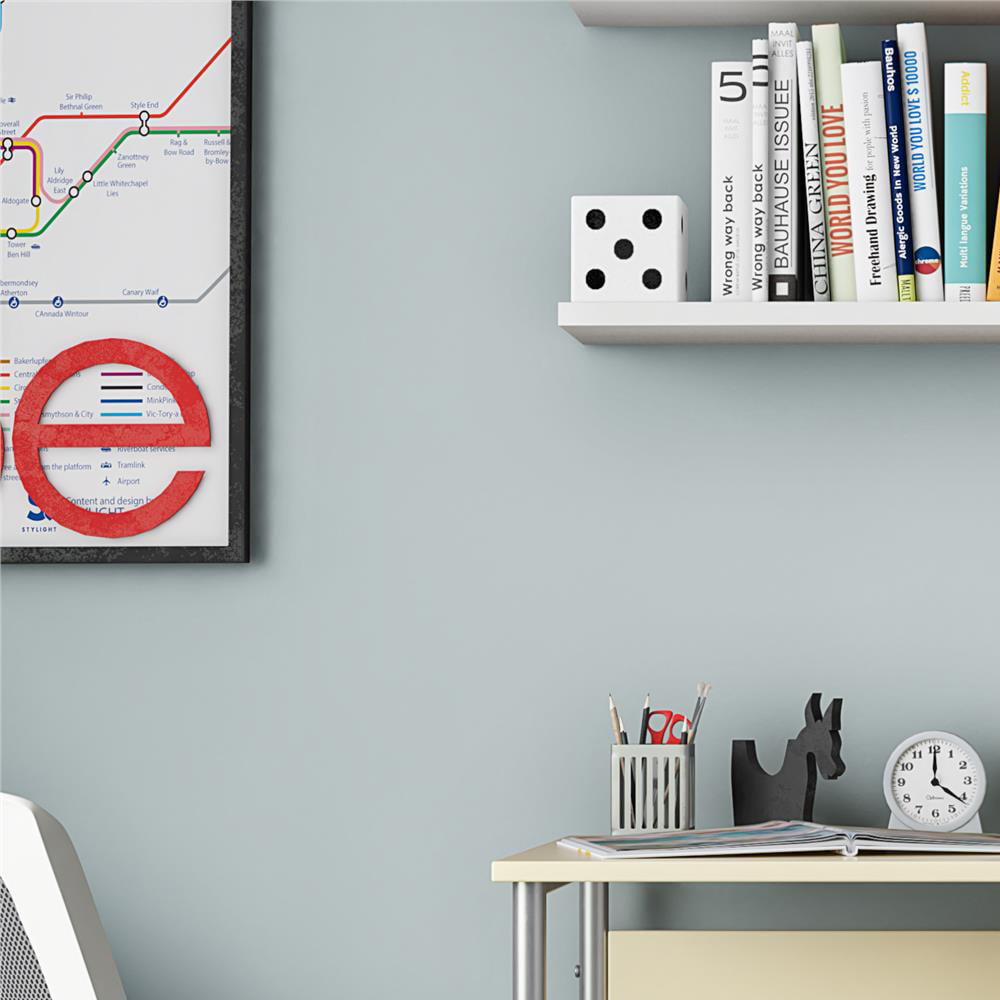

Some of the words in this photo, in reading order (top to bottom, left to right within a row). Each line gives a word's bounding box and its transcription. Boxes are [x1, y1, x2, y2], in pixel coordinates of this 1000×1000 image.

[884, 48, 895, 92] Bauhos
[904, 50, 919, 86] 10000
[75, 93, 93, 101] Philip
[719, 71, 747, 102] 5
[960, 70, 971, 106] Addict
[130, 102, 146, 110] Style
[774, 80, 789, 151] ISSUEE
[908, 98, 922, 124] LOVE
[821, 104, 847, 147] LOVE
[862, 118, 870, 136] with
[170, 139, 182, 147] Rag
[889, 125, 899, 153] World
[910, 126, 924, 151] YOU
[824, 152, 849, 190] YOU
[892, 154, 902, 177] New
[912, 153, 927, 192] WORLD
[47, 177, 74, 185] Aldridge
[110, 180, 148, 188] Whitechapel
[752, 164, 763, 202] back
[804, 143, 822, 214] GREEN
[894, 180, 902, 190] In
[958, 166, 968, 210] Variations
[106, 190, 119, 198] Lies
[723, 176, 734, 212] back
[863, 174, 878, 225] Drawing
[774, 159, 789, 268] BAUHAUSE
[894, 192, 904, 224] Goods
[725, 217, 735, 246] way
[754, 208, 766, 238] way
[828, 194, 854, 257] WORLD
[896, 226, 908, 260] Alergic
[752, 244, 766, 290] Wrong
[810, 222, 828, 295] CHINA
[866, 229, 881, 286] Freehand
[958, 244, 968, 268] Multi
[722, 251, 735, 296] Wrong
[122, 288, 141, 296] Canary
[64, 310, 89, 318] Wintour
[80, 410, 94, 418] City
[64, 464, 92, 472] platform
[117, 478, 140, 486] Airport
[100, 496, 115, 505] and
[116, 496, 144, 508] design
[912, 750, 922, 759] 11
[928, 745, 941, 754] 12
[948, 750, 954, 758] 1
[900, 762, 914, 771] 10
[959, 760, 968, 770] 2
[898, 778, 906, 787] 9
[963, 776, 972, 785] 3
[902, 794, 911, 803] 8
[960, 792, 968, 800] 4
[915, 806, 923, 814] 7
[932, 809, 940, 818] 6
[948, 804, 956, 814] 5
